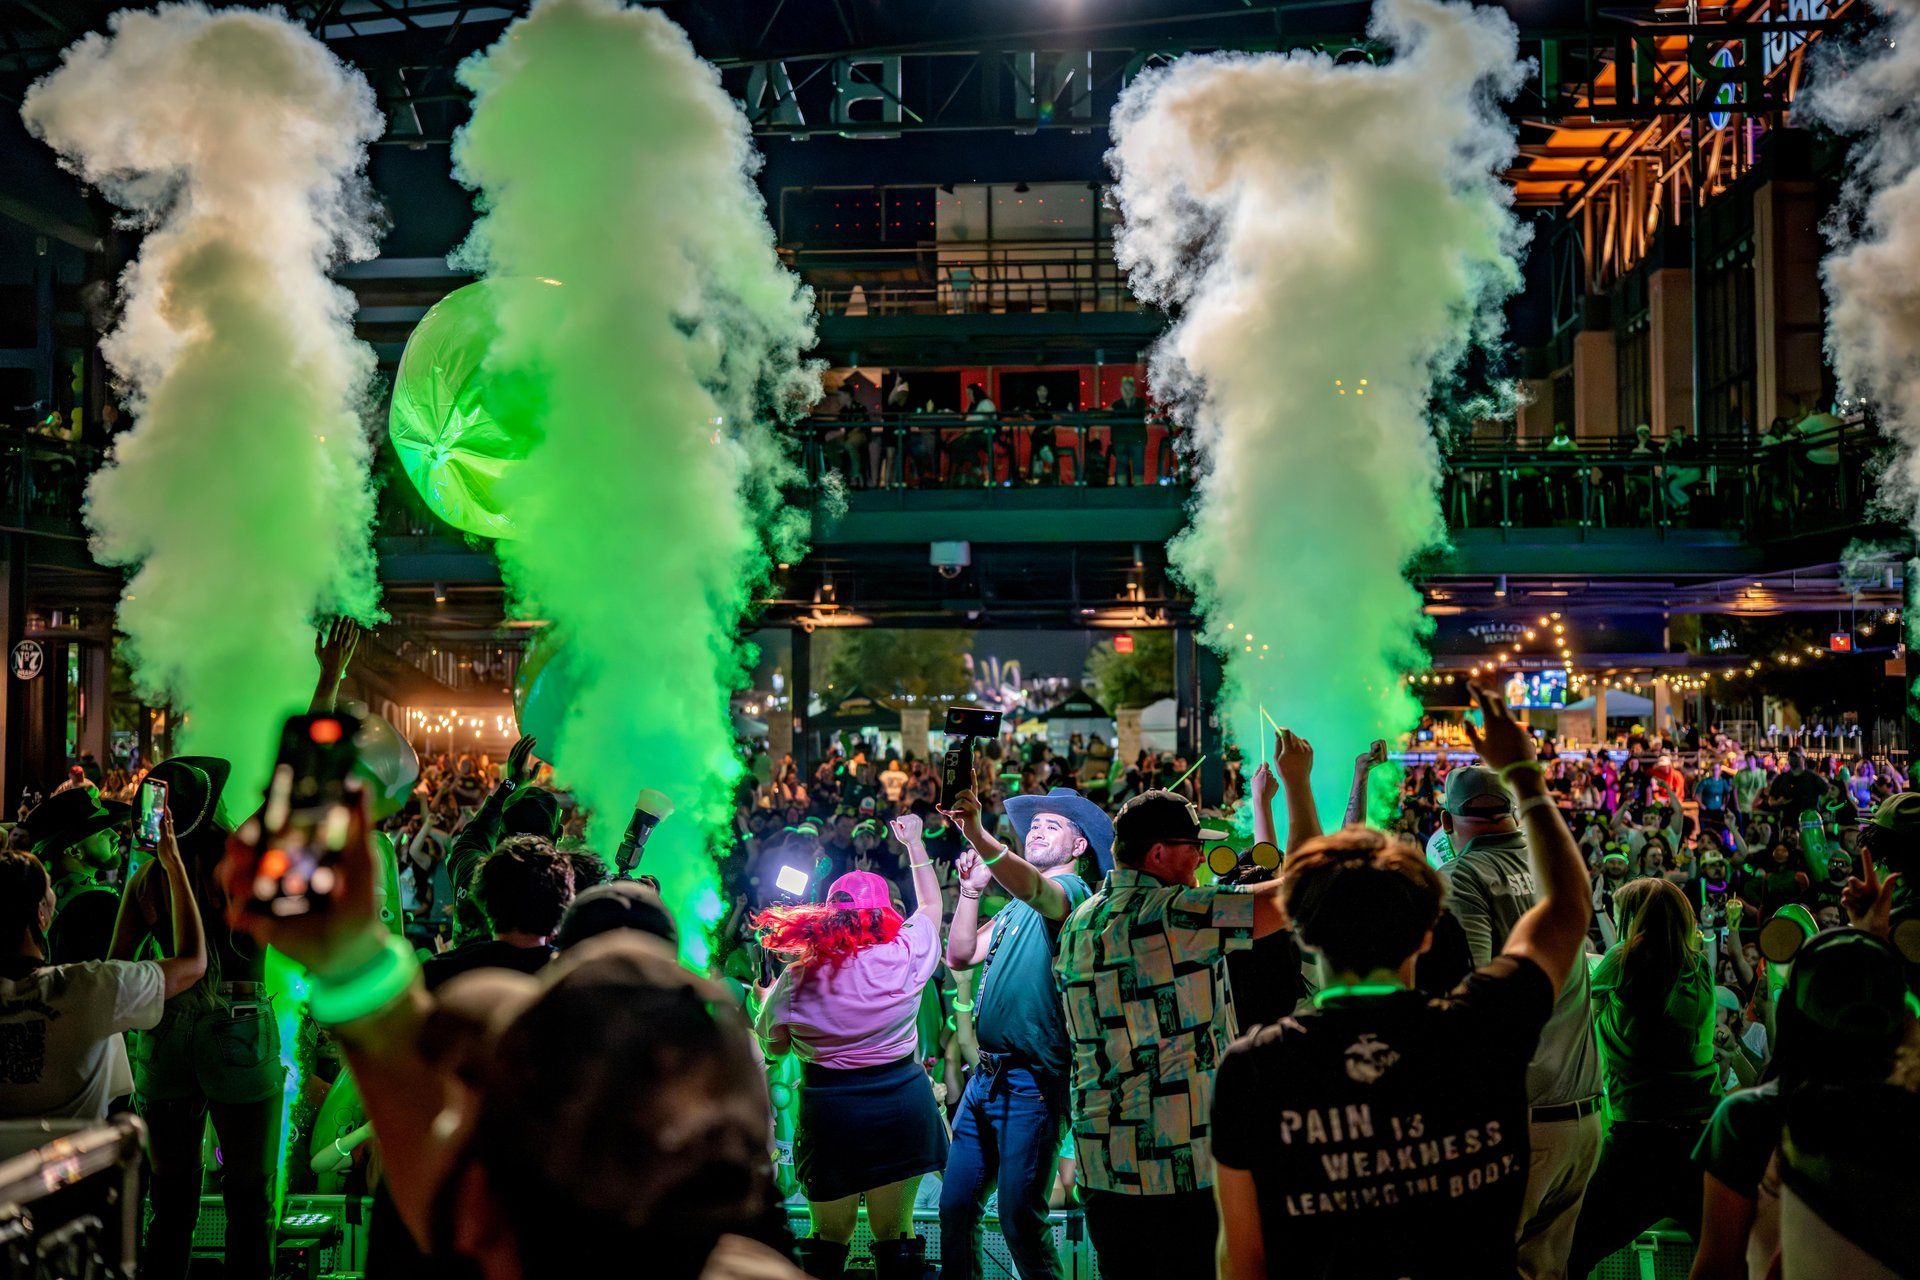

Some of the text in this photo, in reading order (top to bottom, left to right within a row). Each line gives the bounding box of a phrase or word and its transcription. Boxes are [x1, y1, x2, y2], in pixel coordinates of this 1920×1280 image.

[1280, 1103, 1425, 1144] PAIN IS
[1321, 1120, 1502, 1182] WEAKNESS
[1286, 1183, 1400, 1217] LEAVING
[1405, 1175, 1439, 1196] THE
